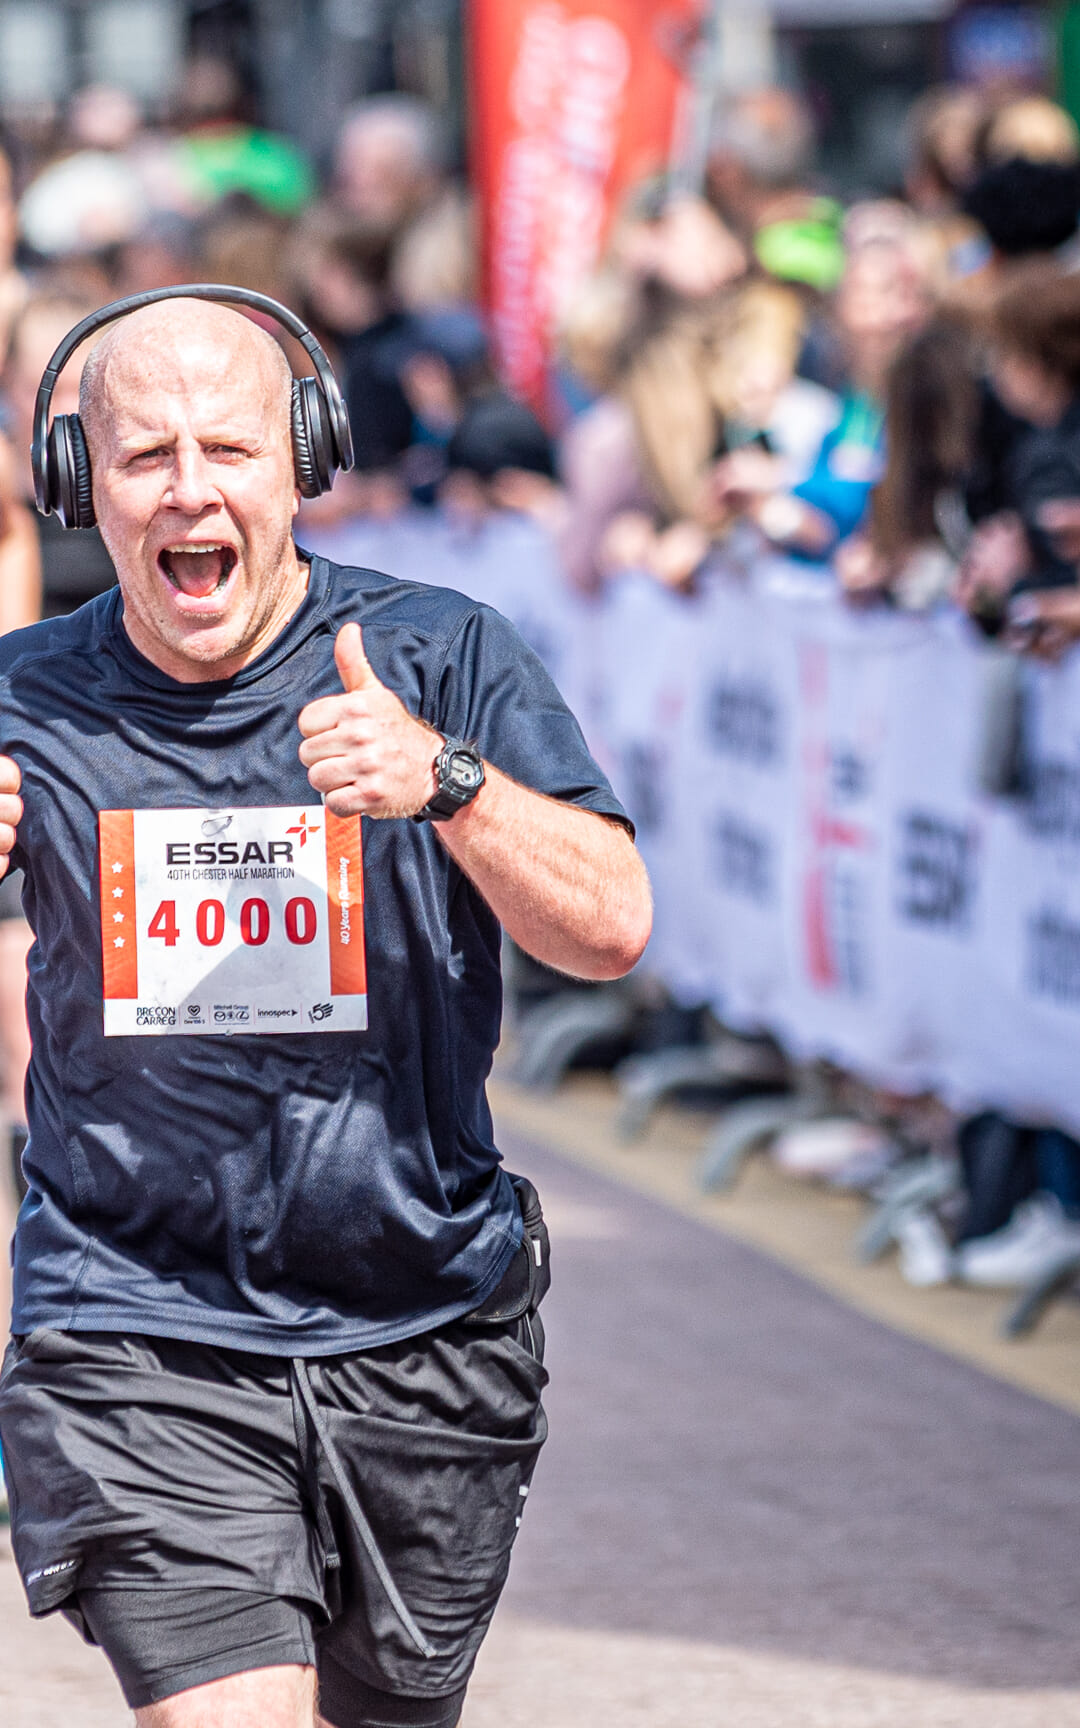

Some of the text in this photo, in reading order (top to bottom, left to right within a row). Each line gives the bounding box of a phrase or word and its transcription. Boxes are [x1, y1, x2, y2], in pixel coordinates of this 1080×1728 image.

[166, 841, 294, 865] ESSAR
[167, 867, 295, 880] 40TH CHESTER HALF MARATHON
[338, 856, 350, 900] Running
[148, 896, 317, 947] 4000
[136, 1007, 176, 1017] BRECON
[257, 1008, 291, 1018] innospec
[136, 1016, 177, 1026] CARREG
